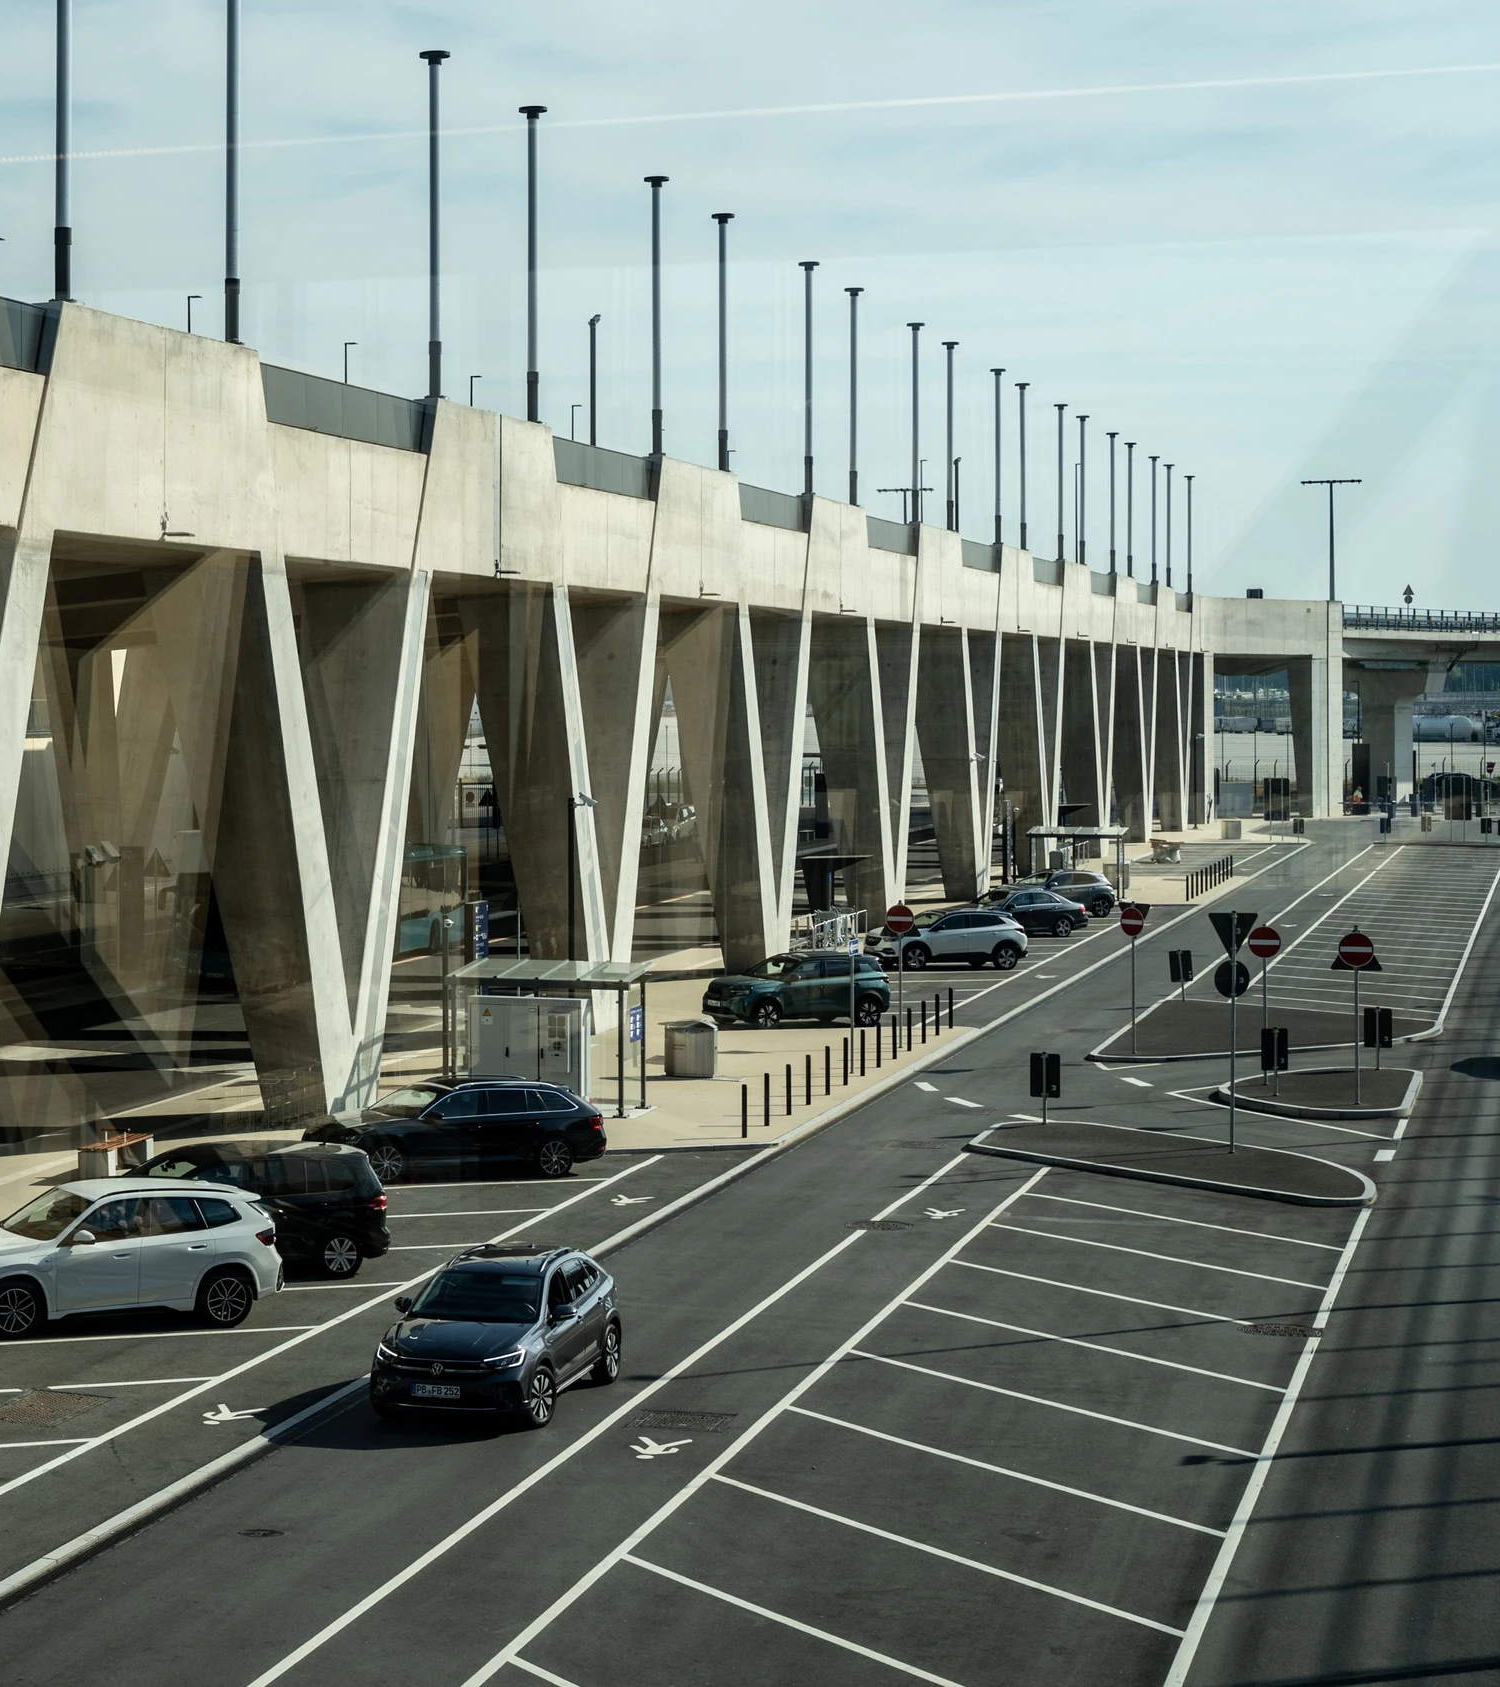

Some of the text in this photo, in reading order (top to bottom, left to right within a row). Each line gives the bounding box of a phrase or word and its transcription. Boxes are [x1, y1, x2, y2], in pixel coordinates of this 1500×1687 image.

[416, 1385, 460, 1395] PB FB 252
